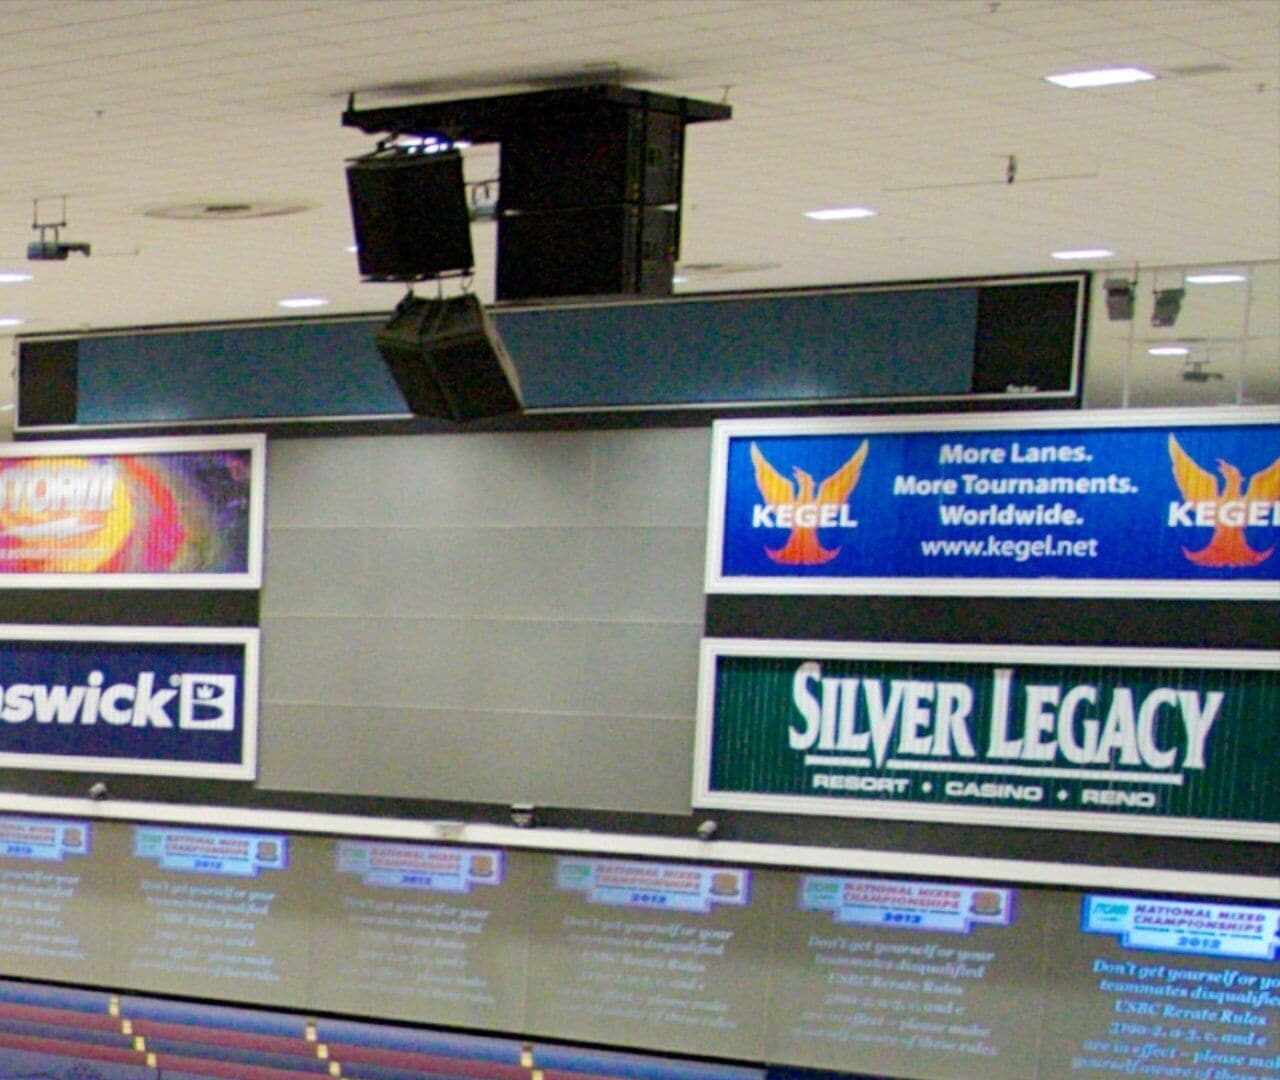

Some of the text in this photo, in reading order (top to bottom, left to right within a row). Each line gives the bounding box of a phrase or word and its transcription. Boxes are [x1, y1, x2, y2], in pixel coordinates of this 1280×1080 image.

[939, 442, 1093, 464] More Lanes.
[893, 474, 1139, 496] More Tournaments.
[752, 503, 858, 529] KEGEL
[939, 503, 1085, 526] Worldwide.
[921, 535, 1098, 562] www.kegel.net
[788, 661, 1225, 770] SILVER LEGACY
[812, 774, 1156, 808] RESORT CASINO RENO
[1133, 915, 1264, 934] CHAMPIONSHIPS
[1135, 904, 1267, 923] NATIONAL MIXED
[1092, 958, 1137, 975] Don't
[1137, 965, 1165, 981] get
[1167, 967, 1240, 987] yourself
[1237, 975, 1258, 985] or
[1100, 979, 1189, 998] teammates
[1220, 1009, 1267, 1026] Rules
[1221, 1032, 1255, 1046] and
[1193, 1049, 1245, 1065] please
